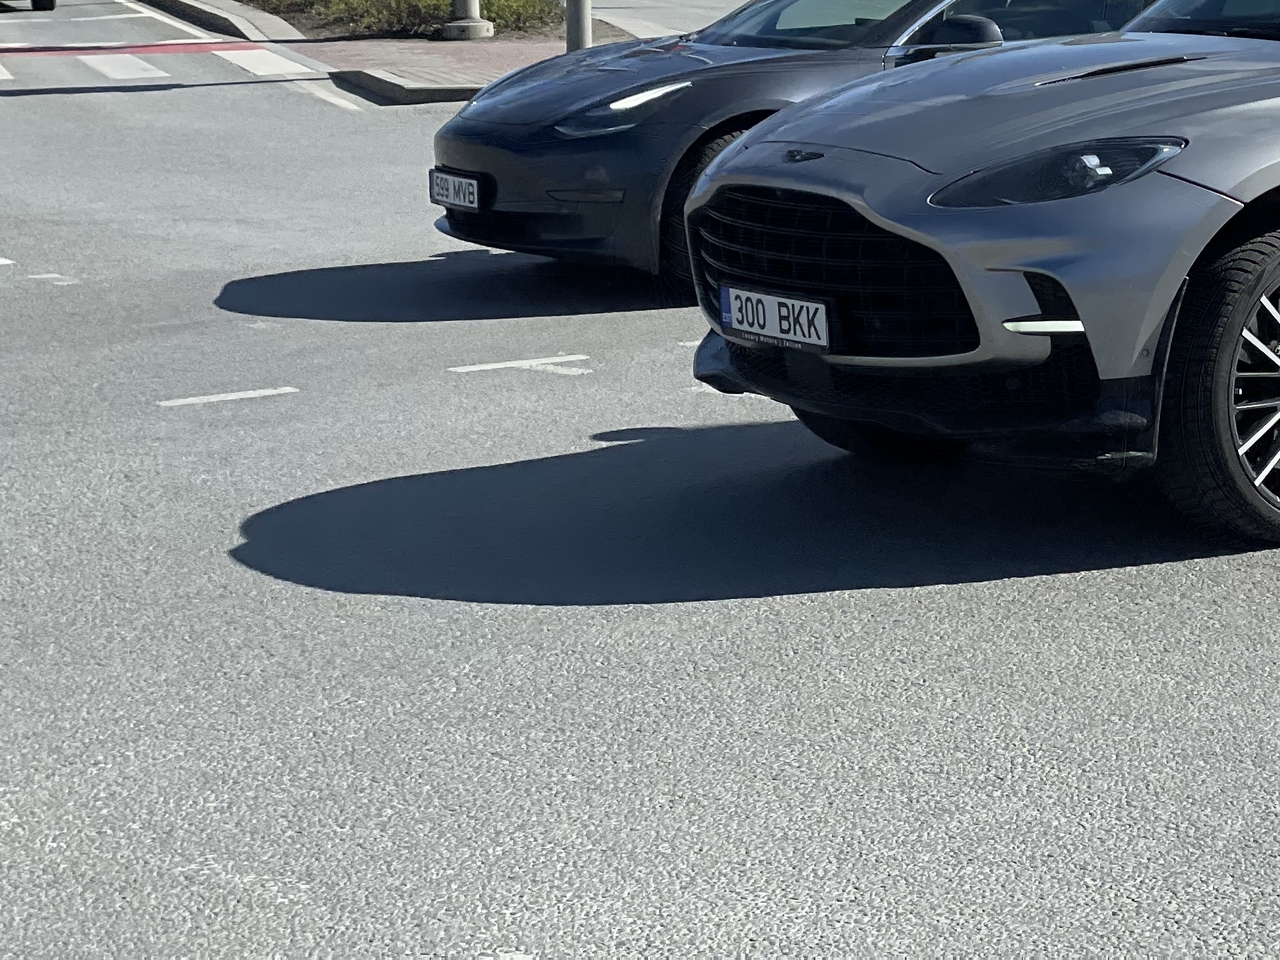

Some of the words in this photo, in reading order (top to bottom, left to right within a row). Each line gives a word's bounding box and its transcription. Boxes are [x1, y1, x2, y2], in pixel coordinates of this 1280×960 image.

[435, 175, 450, 200] 599
[452, 180, 475, 205] MVB
[734, 294, 766, 330] 300
[777, 301, 821, 341] BKK
